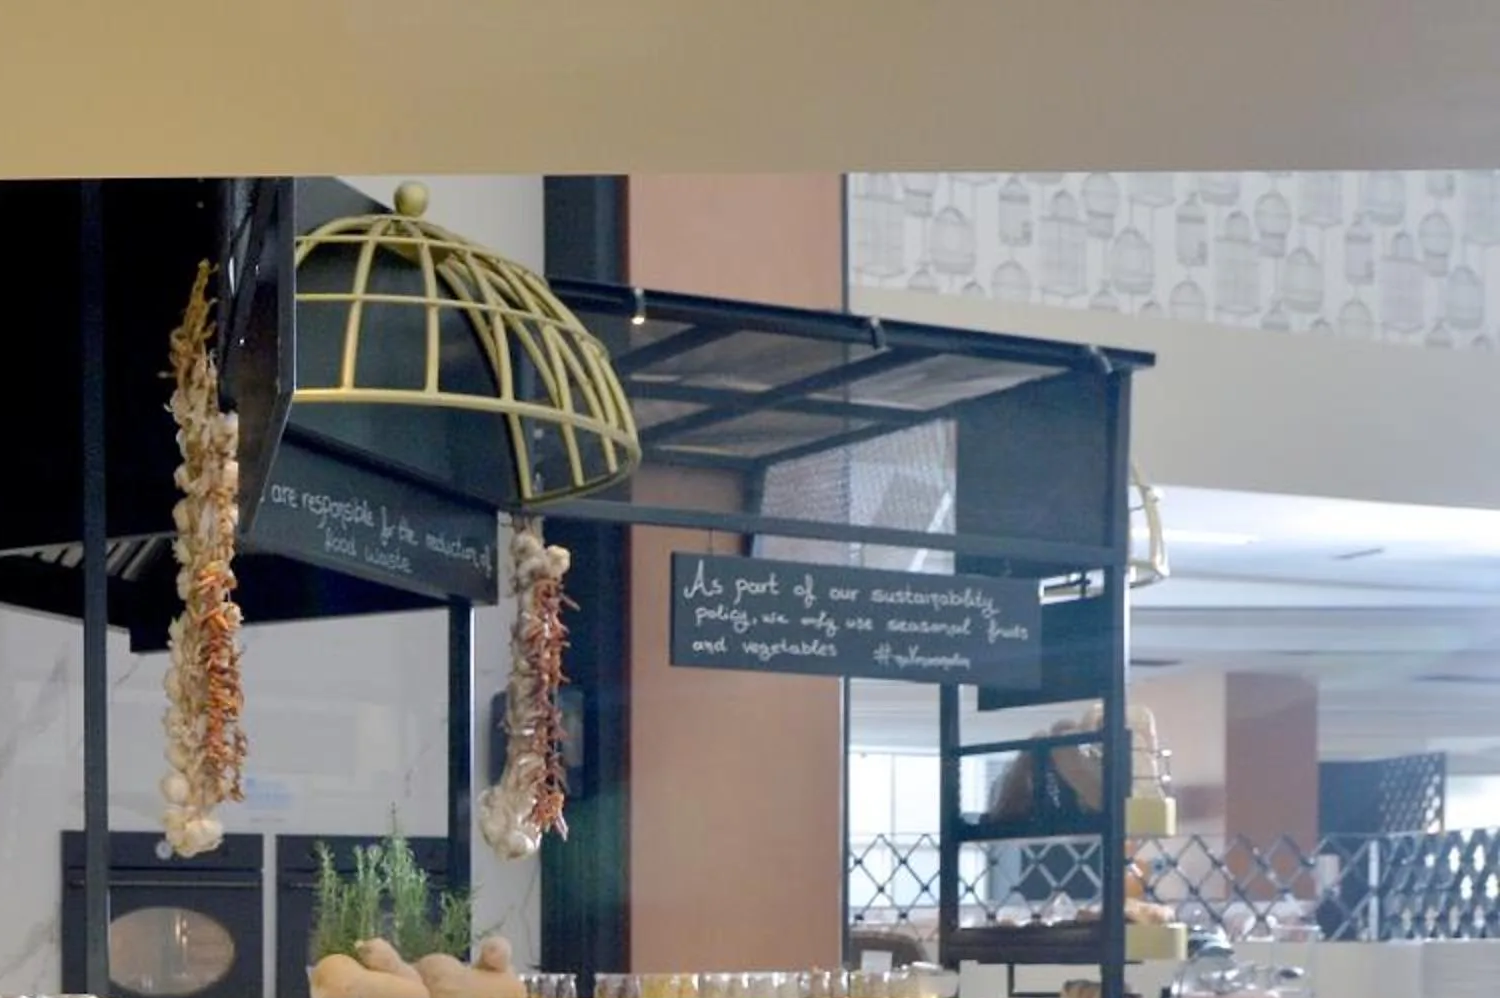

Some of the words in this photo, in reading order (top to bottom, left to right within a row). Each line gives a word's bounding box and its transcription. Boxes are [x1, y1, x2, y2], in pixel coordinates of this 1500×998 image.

[271, 484, 298, 508] are
[302, 491, 375, 530] responsible
[324, 527, 357, 556] food
[683, 559, 724, 599] As
[733, 572, 780, 605] part
[793, 573, 817, 609] of
[828, 587, 859, 602] our
[871, 583, 1001, 620] sustainability
[694, 604, 758, 634] policy,
[762, 612, 790, 625] we
[800, 609, 841, 638] only
[845, 617, 874, 631] use
[886, 616, 972, 637] seasonal
[692, 636, 727, 654] and
[742, 637, 838, 662] vegetables
